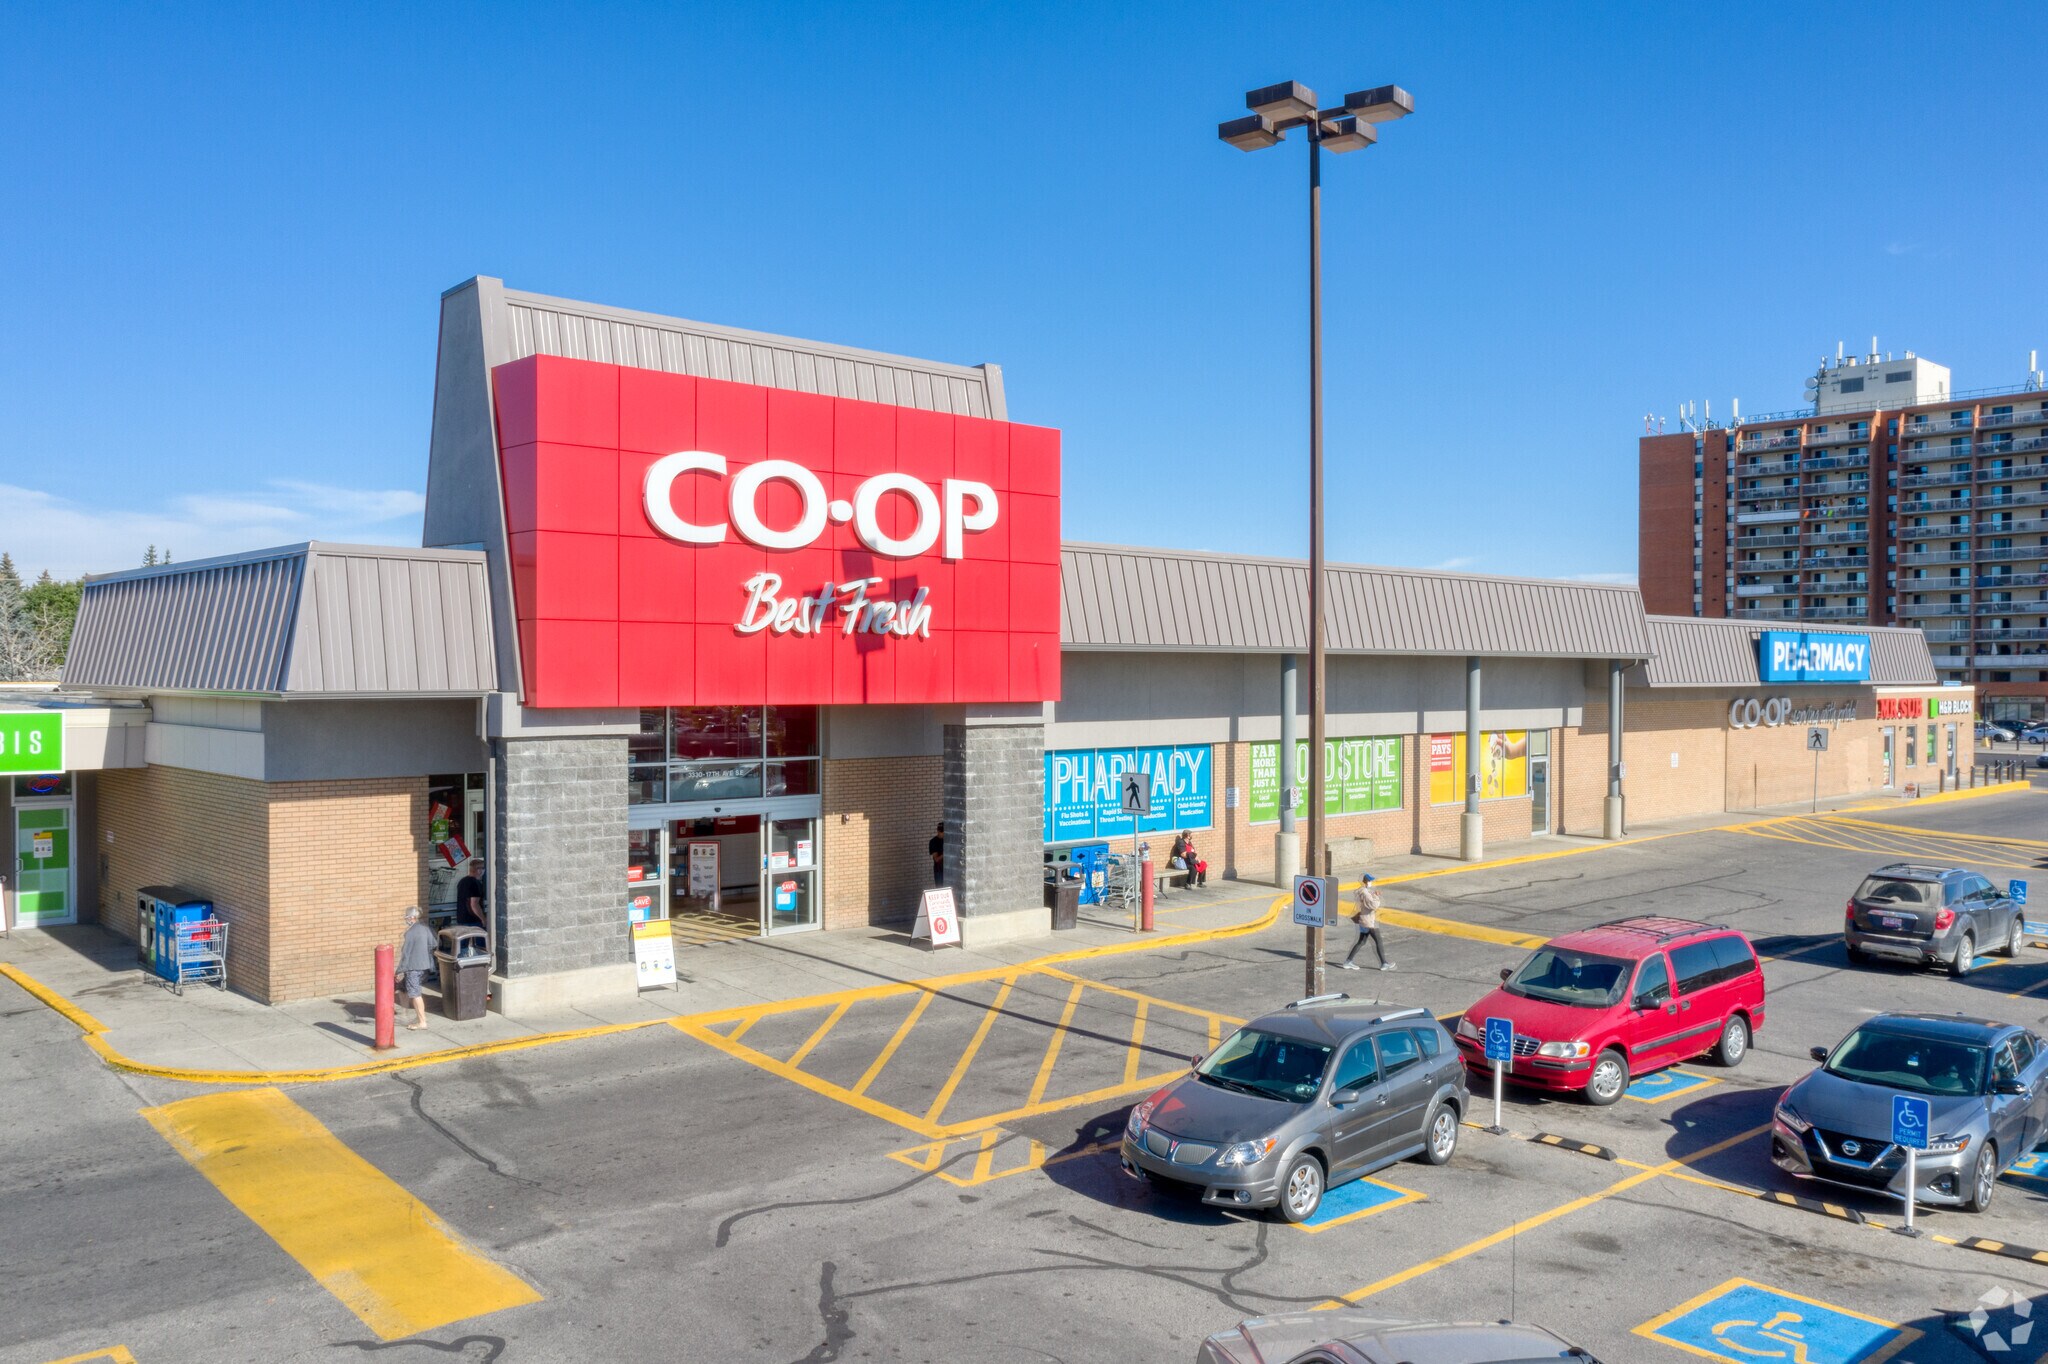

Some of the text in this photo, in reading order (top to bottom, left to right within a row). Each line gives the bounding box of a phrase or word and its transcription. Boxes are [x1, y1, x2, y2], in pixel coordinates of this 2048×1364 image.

[734, 572, 933, 639] Best Fresh
[1773, 641, 1865, 672] PHARMACY
[1953, 700, 1972, 714] BLOCK
[1252, 744, 1276, 758] FAR
[1431, 743, 1452, 756] PAYS
[1252, 758, 1276, 769] MORE
[1338, 738, 1396, 781] STORE
[1252, 767, 1276, 779] THAN
[1252, 778, 1276, 788] JUST A
[1070, 811, 1084, 819] Shots
[1102, 808, 1117, 816] Rapid
[1059, 819, 1091, 827] Vaccinations
[781, 883, 795, 891] SAVE
[634, 898, 649, 907] SAVE
[1295, 913, 1322, 923] CROSSWALK
[1899, 1128, 1921, 1138] PERMIT
[1895, 1134, 1926, 1146] REQUIRED
